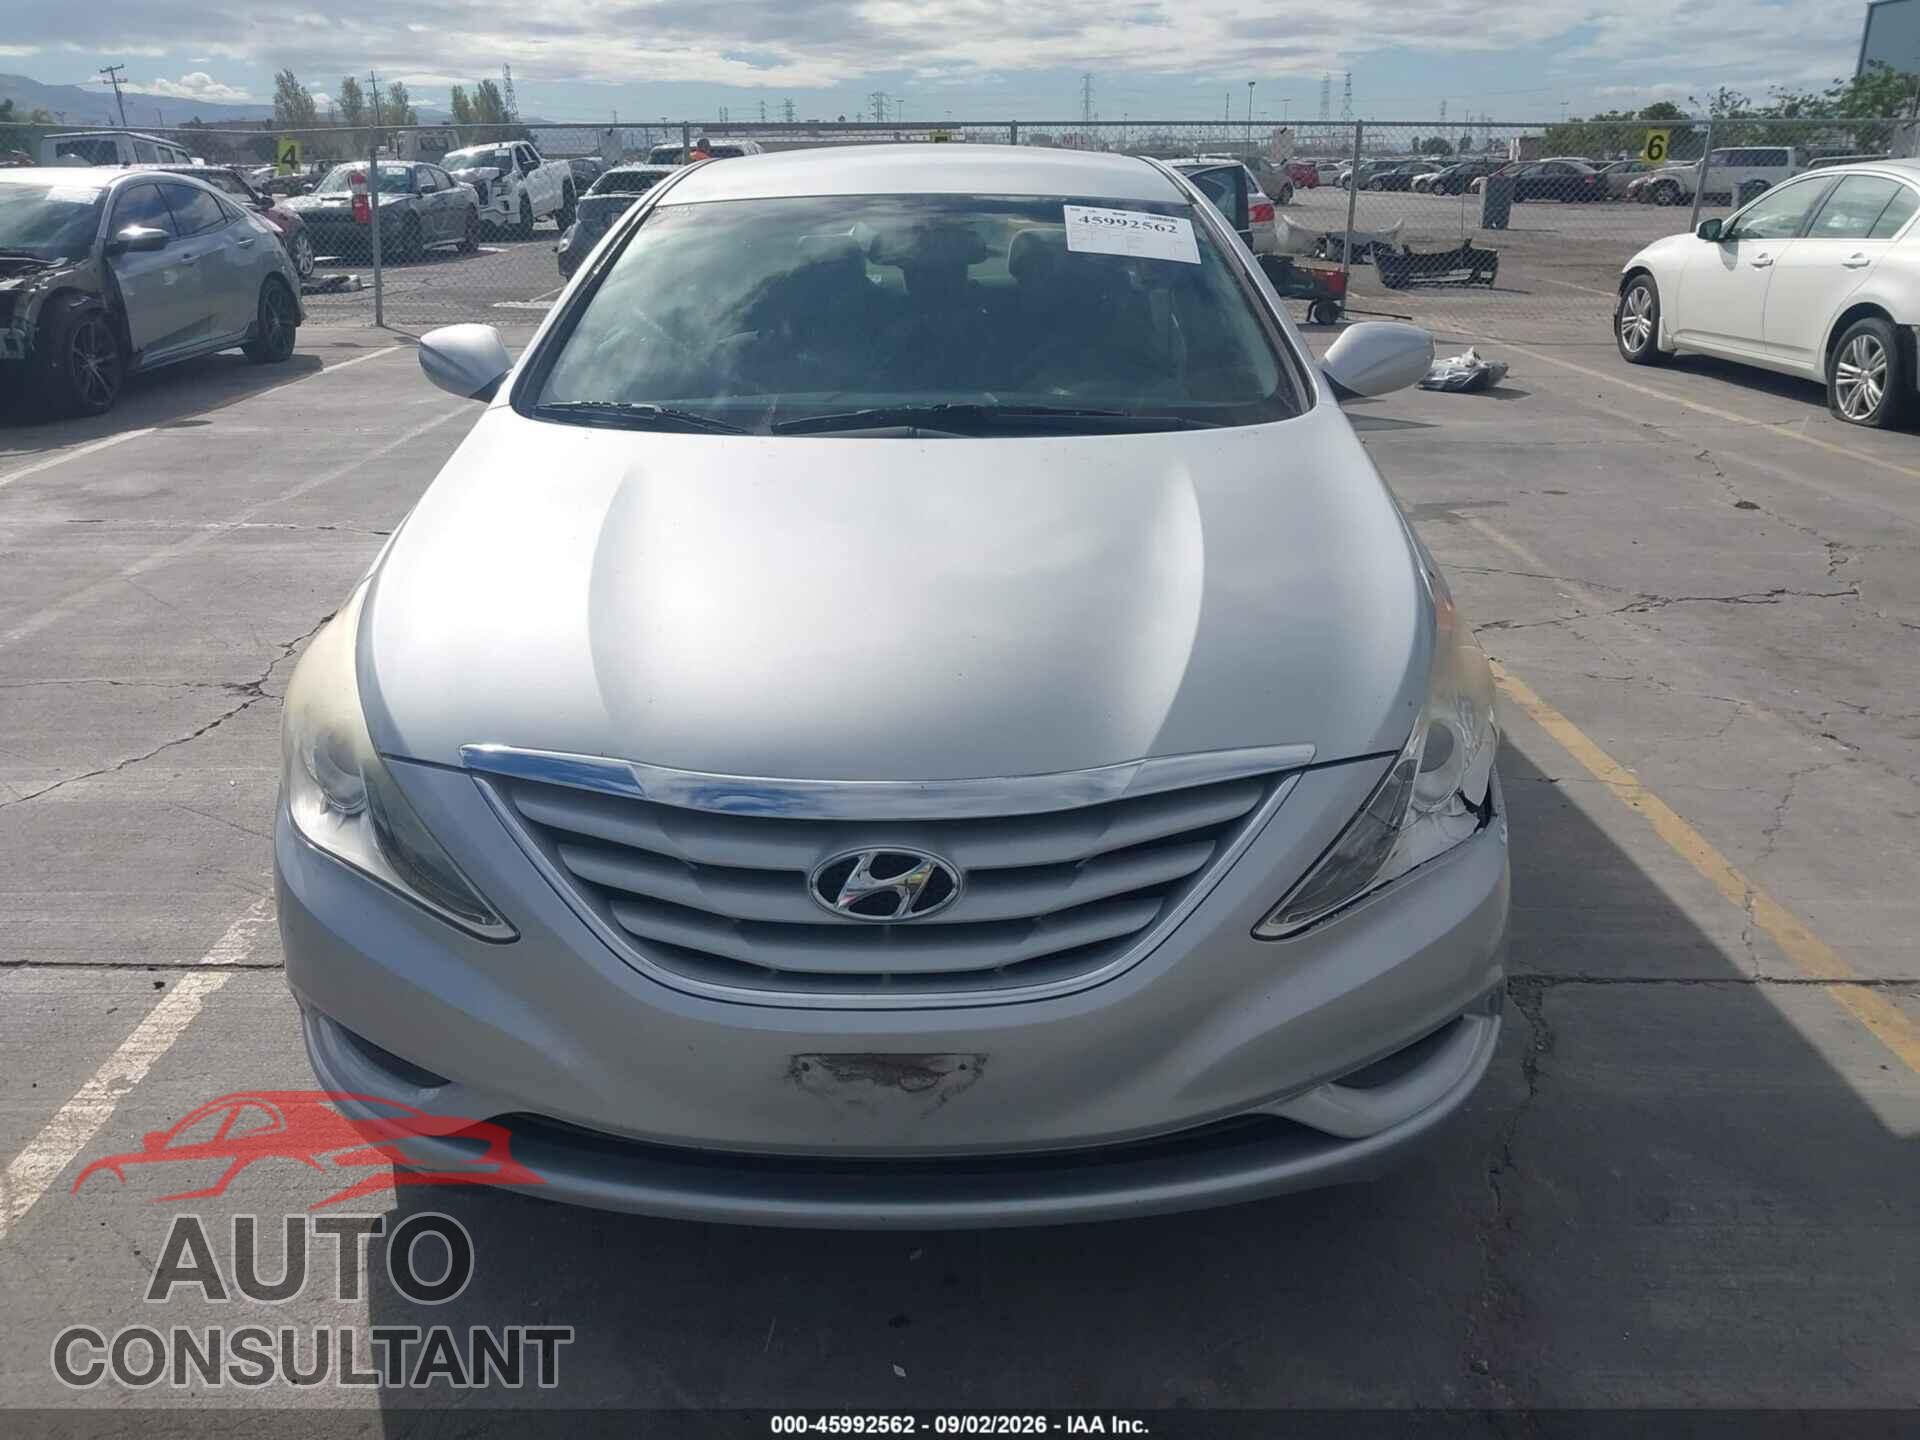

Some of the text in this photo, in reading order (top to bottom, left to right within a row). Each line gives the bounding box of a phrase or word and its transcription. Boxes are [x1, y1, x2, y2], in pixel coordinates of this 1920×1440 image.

[281, 145, 298, 169] 4
[1648, 134, 1665, 160] 6
[1079, 215, 1178, 233] 45992562
